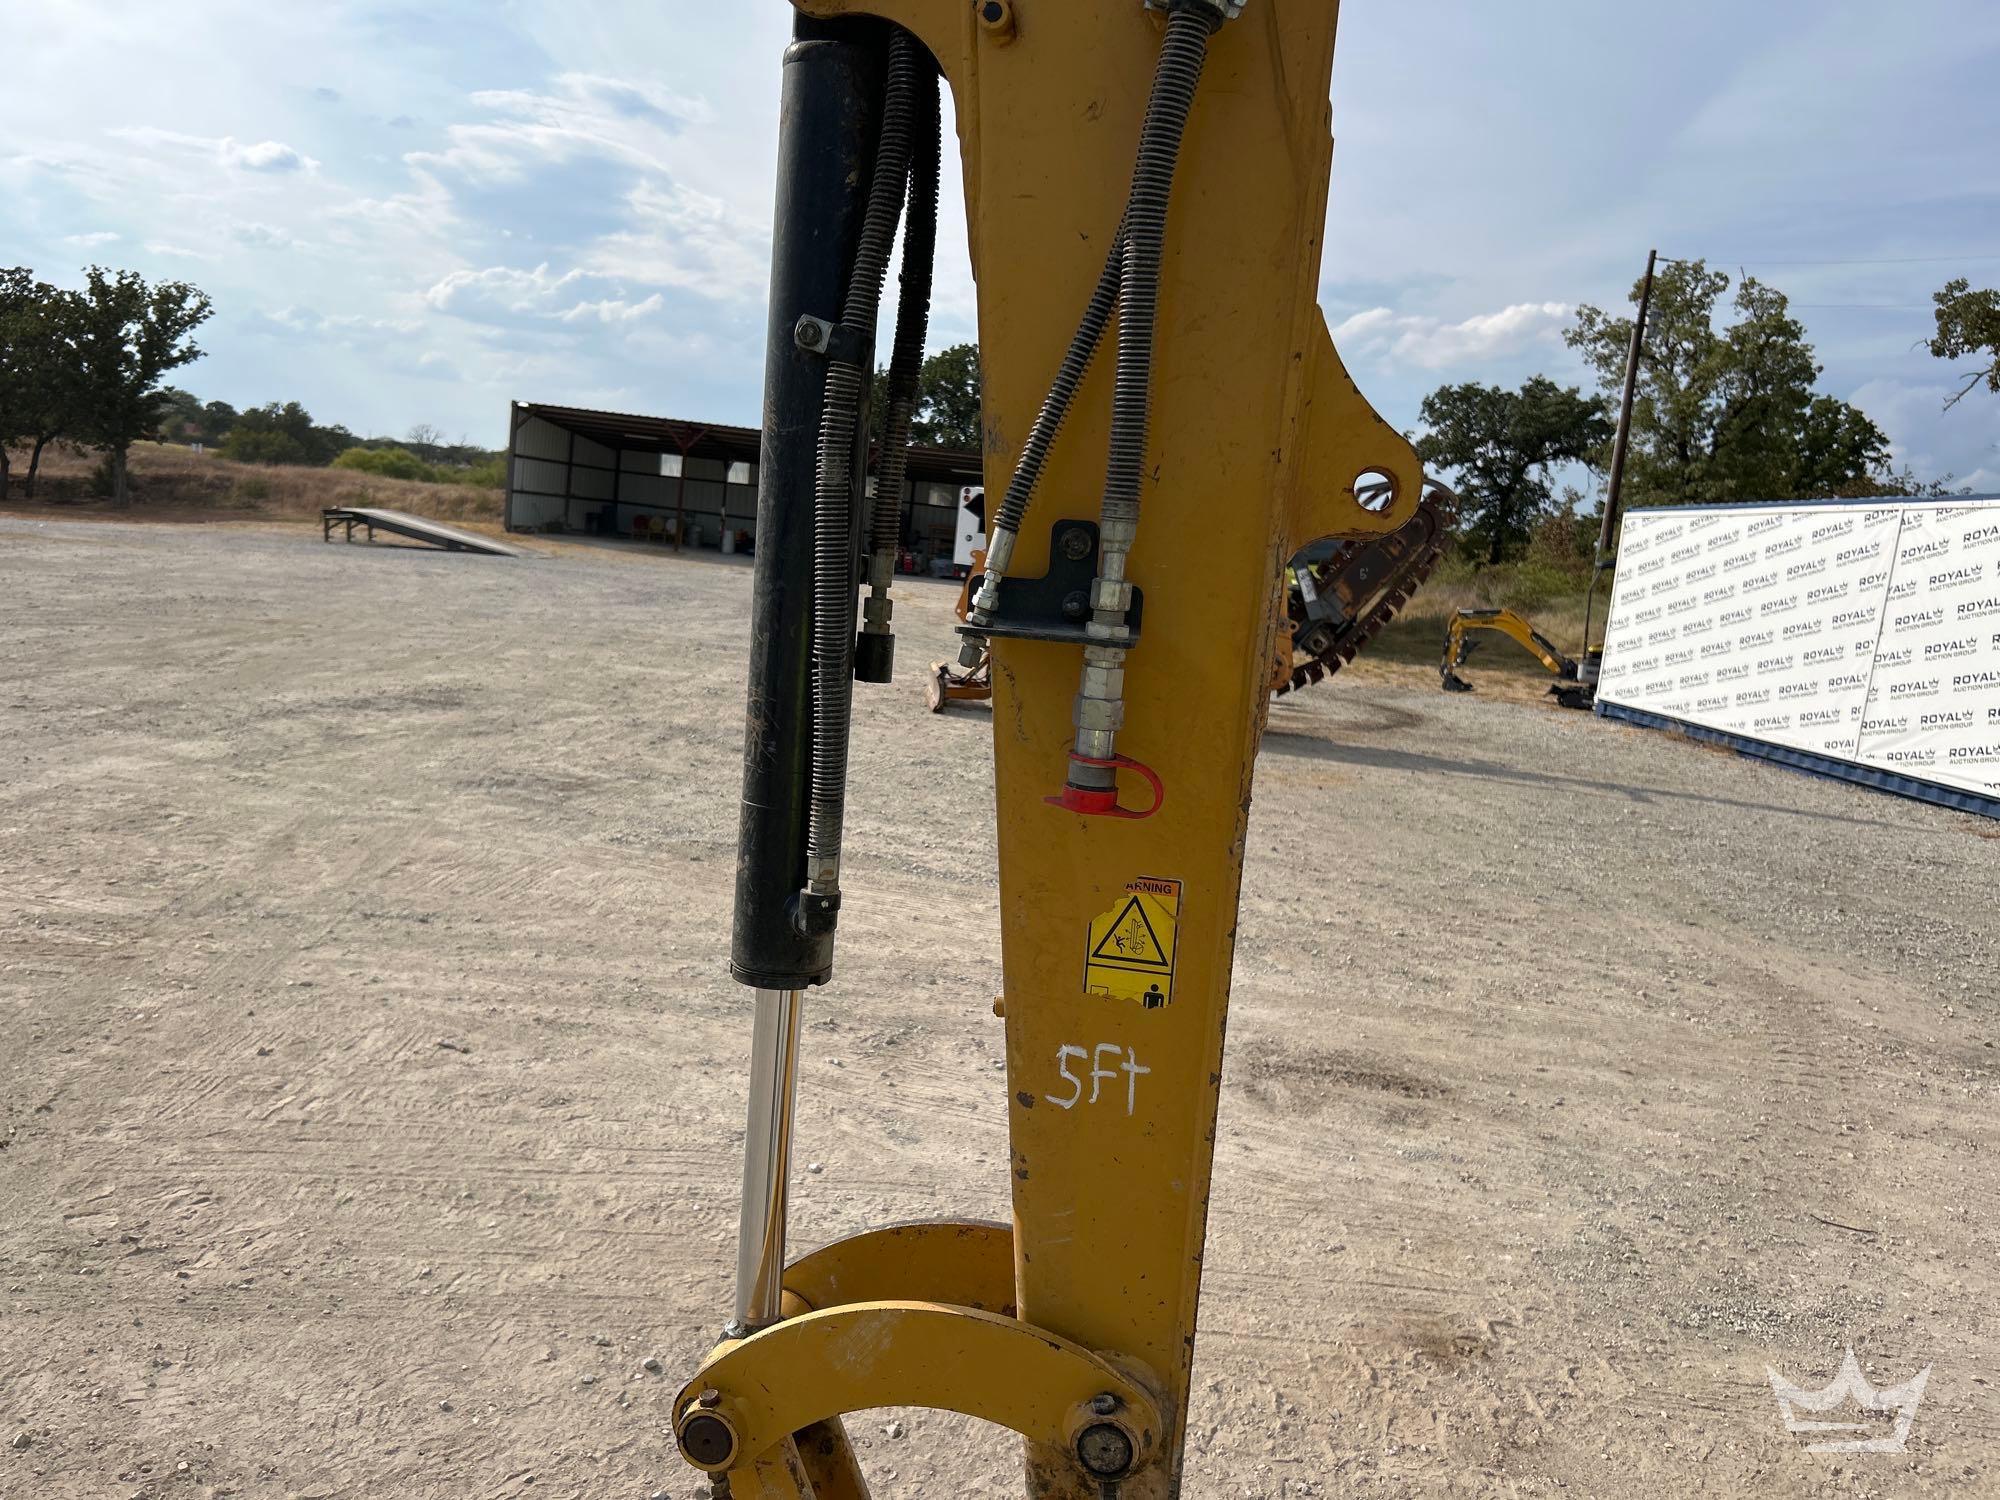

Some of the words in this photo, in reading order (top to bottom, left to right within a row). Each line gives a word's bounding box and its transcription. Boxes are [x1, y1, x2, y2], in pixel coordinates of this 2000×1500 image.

[1748, 517, 1775, 532] ROYAL
[1812, 522, 1844, 538] ROYAL
[1708, 532, 1732, 546] ROYAL
[1964, 526, 1998, 542] ROYA
[1766, 539, 1794, 554] ROYAL
[1836, 546, 1870, 560] ROYAL
[1901, 542, 1938, 558] ROYAL
[1724, 554, 1749, 567] ROYAL
[1786, 561, 1817, 576] ROYAL
[1742, 574, 1770, 588] ROYAL
[1860, 572, 1887, 586] ROYA
[1930, 568, 1970, 585] ROYAL
[1808, 585, 1838, 599] ROYAL
[1761, 598, 1789, 611] ROYAL
[1958, 597, 2000, 614] ROYAL
[1832, 610, 1866, 624] ROYAL
[1895, 611, 1932, 626] ROYAL
[1783, 622, 1812, 634] ROYAL
[1740, 633, 1766, 644] ROYAL
[1925, 640, 1965, 654] ROYAL
[1804, 648, 1835, 660] ROYAL
[1874, 651, 1902, 662] OYAL
[1758, 658, 1784, 668] ROYAL
[1829, 675, 1862, 686] ROYAL
[1953, 672, 1996, 686] ROYAL
[1779, 683, 1809, 694] ROYAL
[1890, 681, 1928, 694] ROYAL
[1736, 692, 1762, 700] ROYAL
[1800, 710, 1830, 720] ROYAL
[1920, 712, 1962, 724] ROYAL
[1754, 717, 1781, 727] ROYAL
[1861, 718, 1897, 730] ROYAL
[1887, 750, 1924, 760] ROYAL
[1949, 746, 1992, 757] ROYAL
[1126, 882, 1172, 894] ARNING
